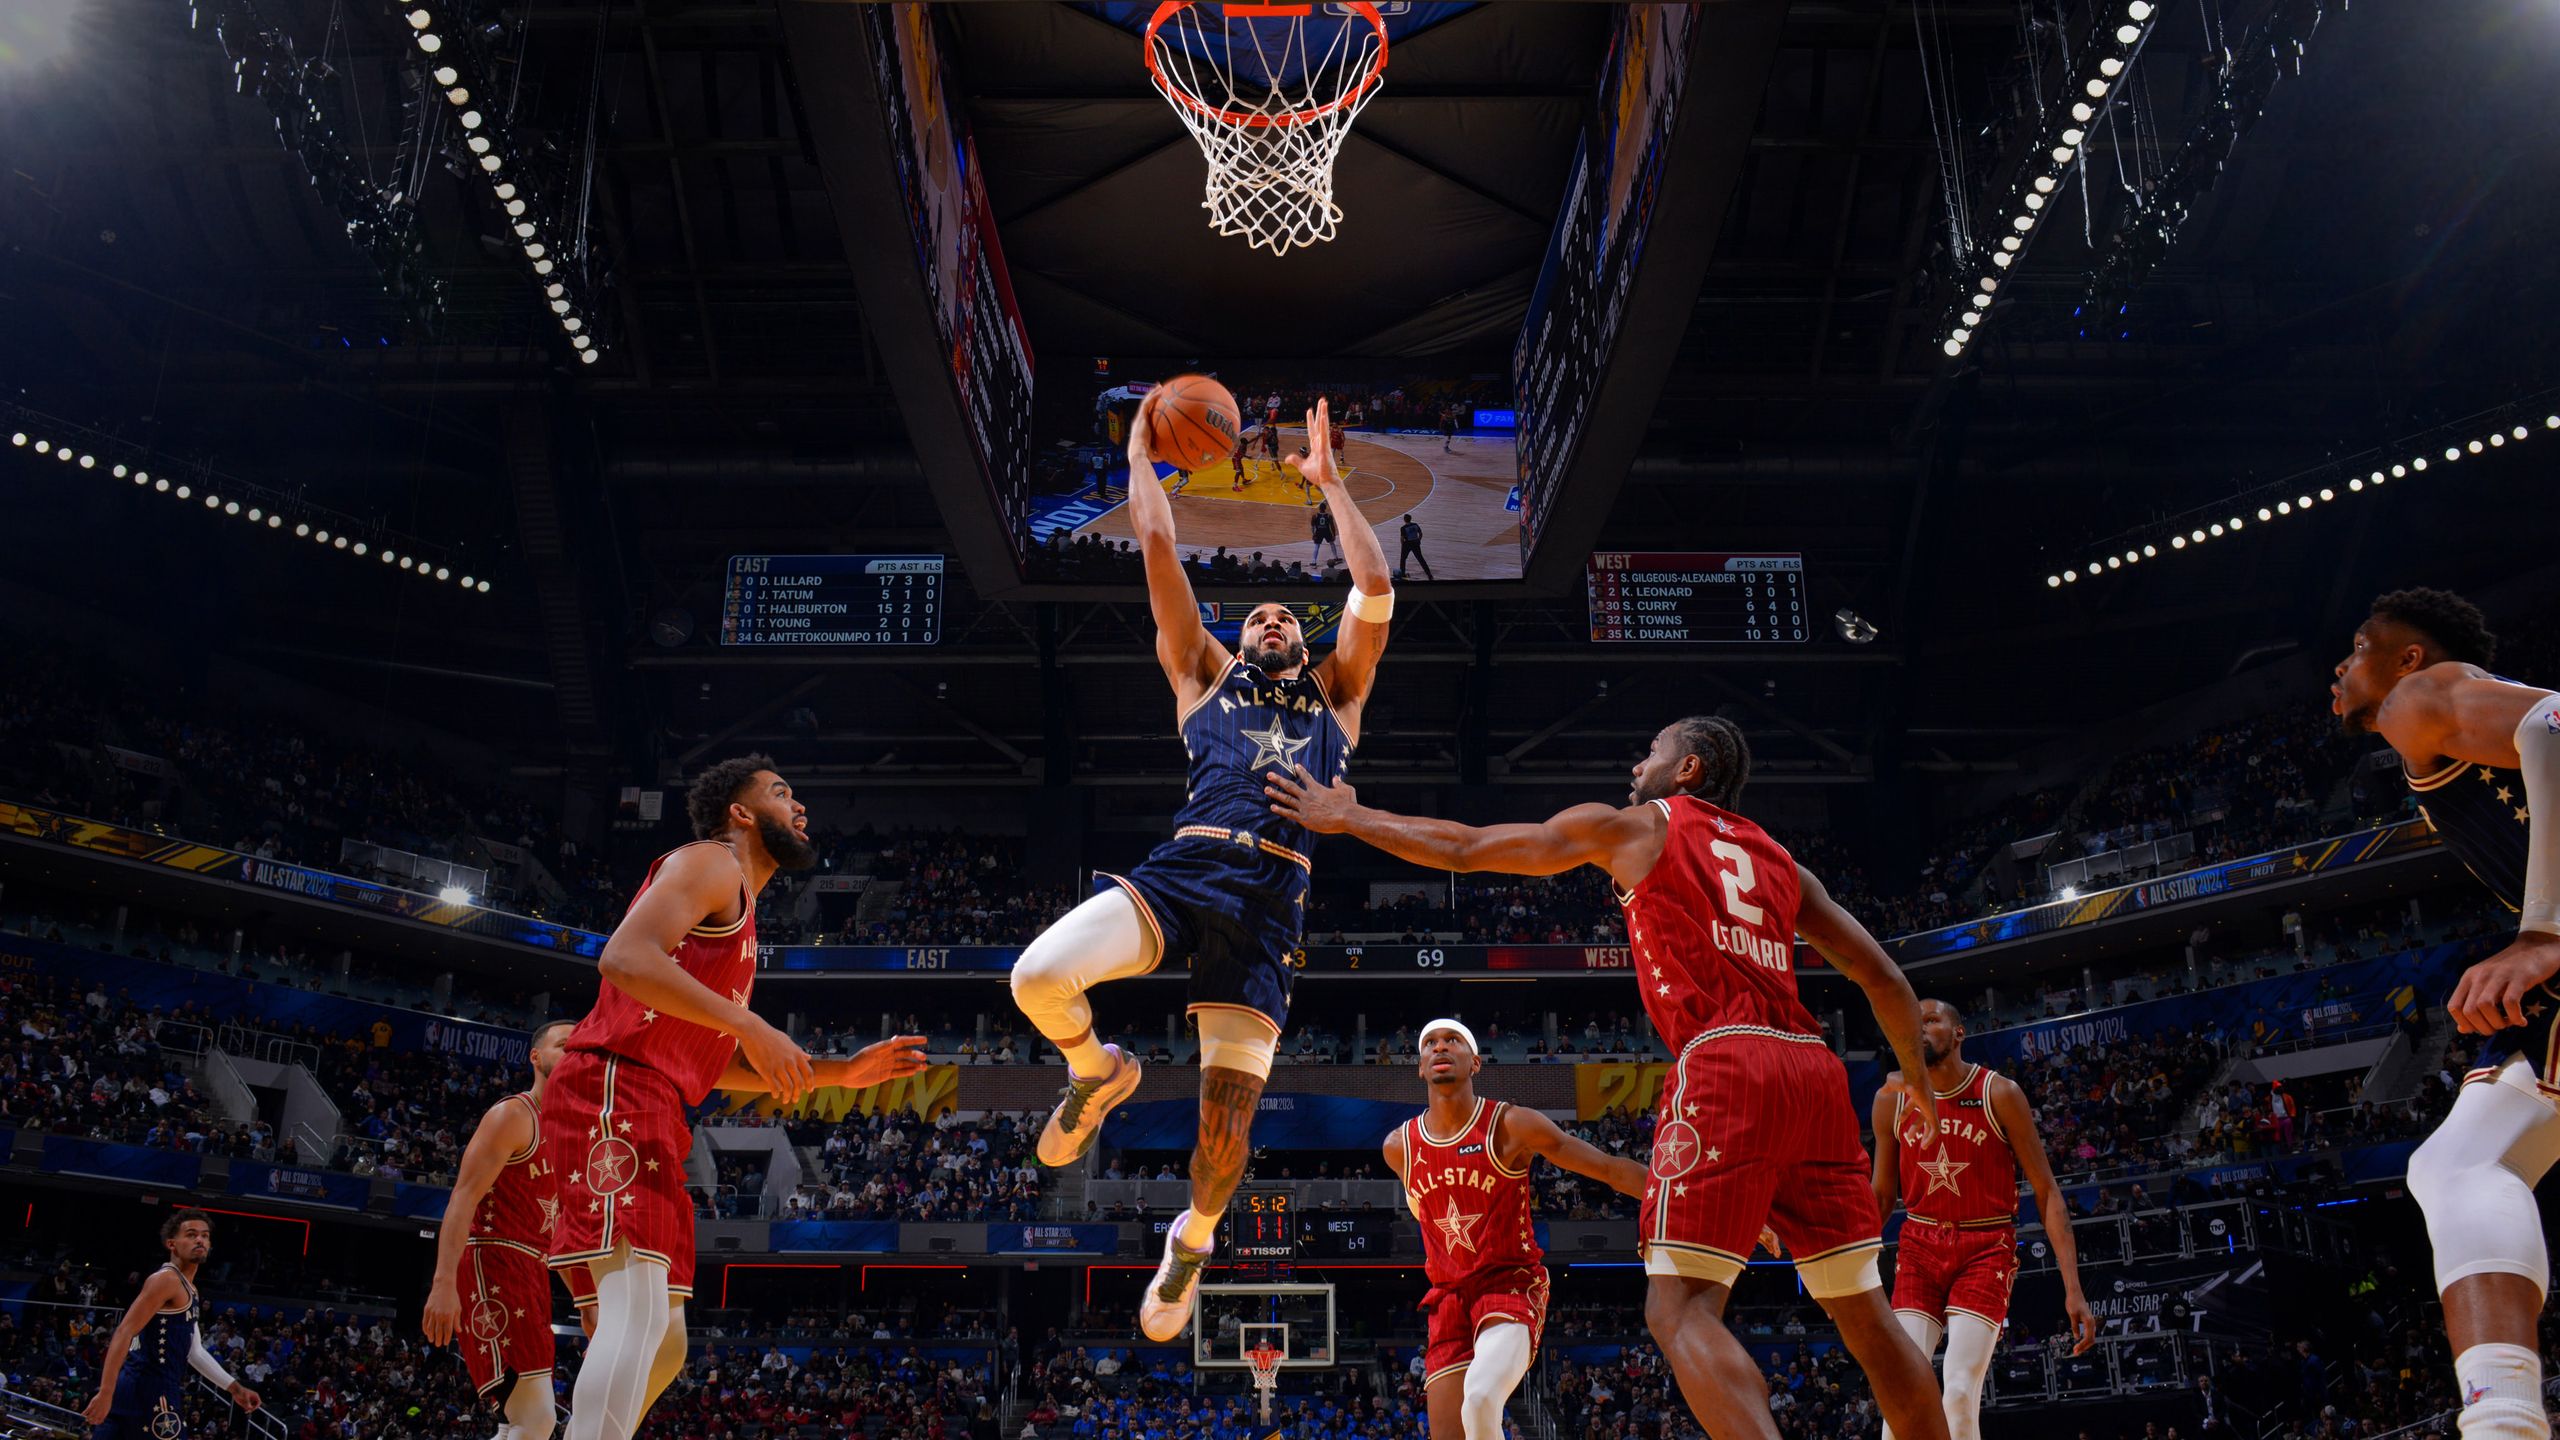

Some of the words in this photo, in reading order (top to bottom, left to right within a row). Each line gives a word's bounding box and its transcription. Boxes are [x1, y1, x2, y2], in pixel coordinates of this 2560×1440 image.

[735, 558, 770, 572] EAST
[877, 563, 896, 571] PTS
[900, 563, 919, 571] AST
[924, 563, 941, 571] FLS
[1594, 555, 1632, 569] WEST
[746, 577, 754, 586] 0
[759, 576, 770, 586] D.
[773, 576, 822, 586] LILLARD
[879, 576, 894, 586] 17
[904, 576, 913, 586] 3
[927, 576, 935, 586] 0
[1608, 573, 1614, 583] 2
[1620, 573, 1630, 583] S.
[1632, 573, 1736, 583] GILGEOUS-ALEXANDER
[1741, 573, 1756, 583] 10
[1766, 573, 1774, 583] 2
[1788, 573, 1796, 583] 0
[745, 591, 752, 600] 0
[758, 590, 768, 600] J.
[772, 590, 813, 600] TATUM
[881, 590, 890, 600] 5
[904, 590, 910, 600] 1
[926, 590, 934, 600] 0
[1608, 587, 1615, 597] 2
[1621, 587, 1633, 597] K.
[1636, 587, 1693, 597] LEONARD
[1745, 587, 1753, 597] 3
[1767, 587, 1775, 597] 0
[1790, 587, 1796, 597] 1
[744, 605, 750, 614] 0
[757, 604, 767, 614] T.
[770, 604, 847, 614] HALIBURTON
[877, 604, 892, 614] 15
[903, 604, 911, 614] 2
[925, 604, 933, 614] 0
[1606, 601, 1620, 611] 30
[1623, 601, 1634, 611] S.
[1637, 601, 1677, 611] CURRY
[1746, 601, 1754, 611] 6
[1768, 601, 1777, 611] 4
[1791, 601, 1799, 611] 0
[740, 618, 751, 628] 11
[756, 618, 766, 628] T.
[769, 618, 811, 628] YOUNG
[880, 618, 888, 628] 2
[902, 618, 910, 628] 0
[925, 618, 931, 628] 1
[1607, 615, 1621, 625] 32
[1624, 615, 1635, 625] K.
[1638, 615, 1682, 625] TOWNS
[1747, 615, 1756, 625] 4
[1770, 615, 1778, 625] 0
[1792, 615, 1800, 625] 0
[738, 632, 751, 642] 34
[755, 632, 766, 642] G.
[768, 632, 871, 642] ANTETOKOUNMPO
[876, 632, 891, 642] 10
[902, 632, 907, 642] 1
[924, 632, 932, 642] 0
[1608, 629, 1622, 639] 35
[1625, 629, 1637, 639] K.
[1640, 629, 1689, 639] DURANT
[1745, 629, 1761, 639] 10
[1771, 629, 1779, 639] 3
[1793, 629, 1801, 639] 0
[2374, 753, 2394, 767] 220
[819, 880, 834, 889] 215
[1709, 838, 1764, 926] 2
[2197, 872, 2222, 895] 2024
[2250, 863, 2276, 878] INDY
[304, 872, 332, 897] 2024
[357, 890, 384, 904] INDY
[759, 947, 774, 955] FLS
[763, 956, 768, 969] 1
[907, 949, 950, 969] EAST
[1350, 956, 1359, 968] 2
[1416, 949, 1445, 968] 69
[1584, 947, 1630, 968] WEST
[1409, 1167, 1497, 1204] ALL-STAR
[1251, 1196, 1286, 1213] 5:12
[1328, 1221, 1354, 1232] WEST
[1349, 1237, 1365, 1249] 69
[1252, 1247, 1292, 1255] TISSOT
[2109, 1294, 2159, 1315] ALL-STAR
